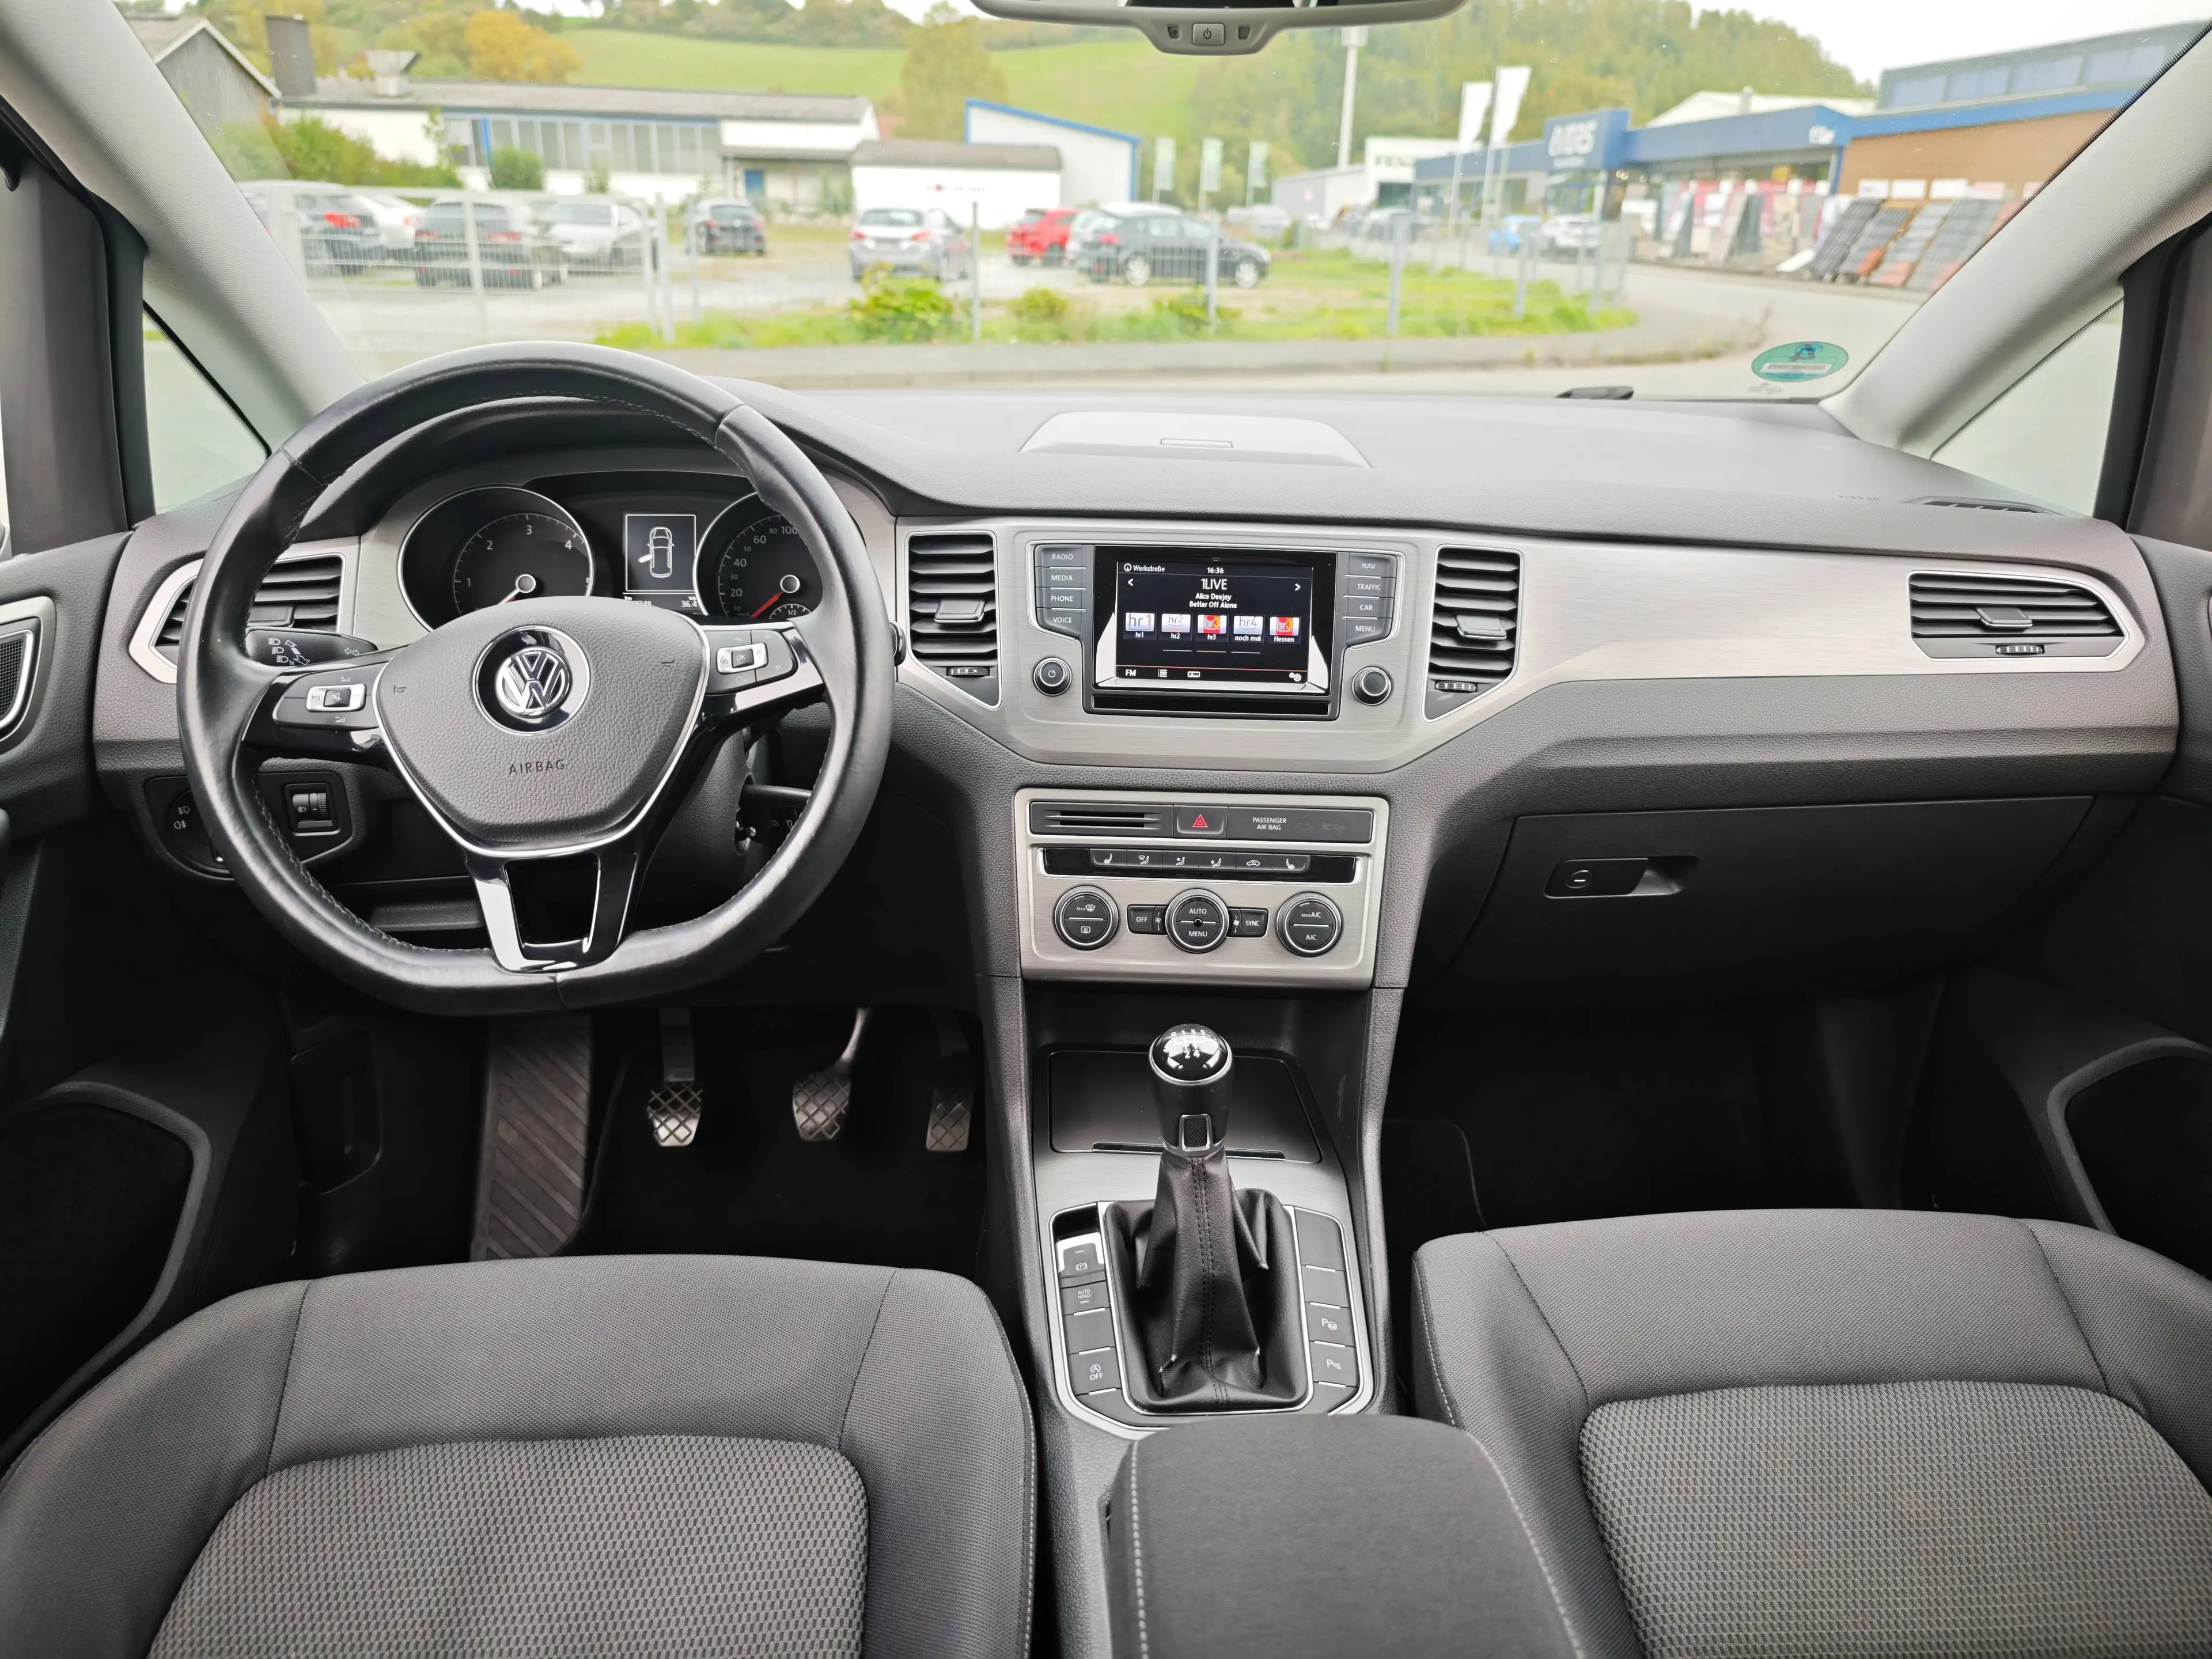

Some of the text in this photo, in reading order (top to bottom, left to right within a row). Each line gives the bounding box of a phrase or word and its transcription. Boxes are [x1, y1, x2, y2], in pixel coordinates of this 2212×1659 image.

[527, 525, 532, 535] 3
[753, 535, 767, 544] 60
[487, 540, 493, 550] 2
[565, 540, 573, 550] 4
[734, 559, 747, 567] 40
[467, 578, 471, 587] 1
[1201, 578, 1228, 590] 1LIVE
[730, 588, 742, 597] 20
[1211, 593, 1232, 601] Deejay
[1129, 613, 1152, 626] hr1
[1169, 615, 1183, 624] hr2
[1239, 616, 1256, 627] hr4
[509, 759, 565, 775] AIRBAG
[1184, 1051, 1191, 1059] 2
[1089, 1372, 1104, 1381] OFF
